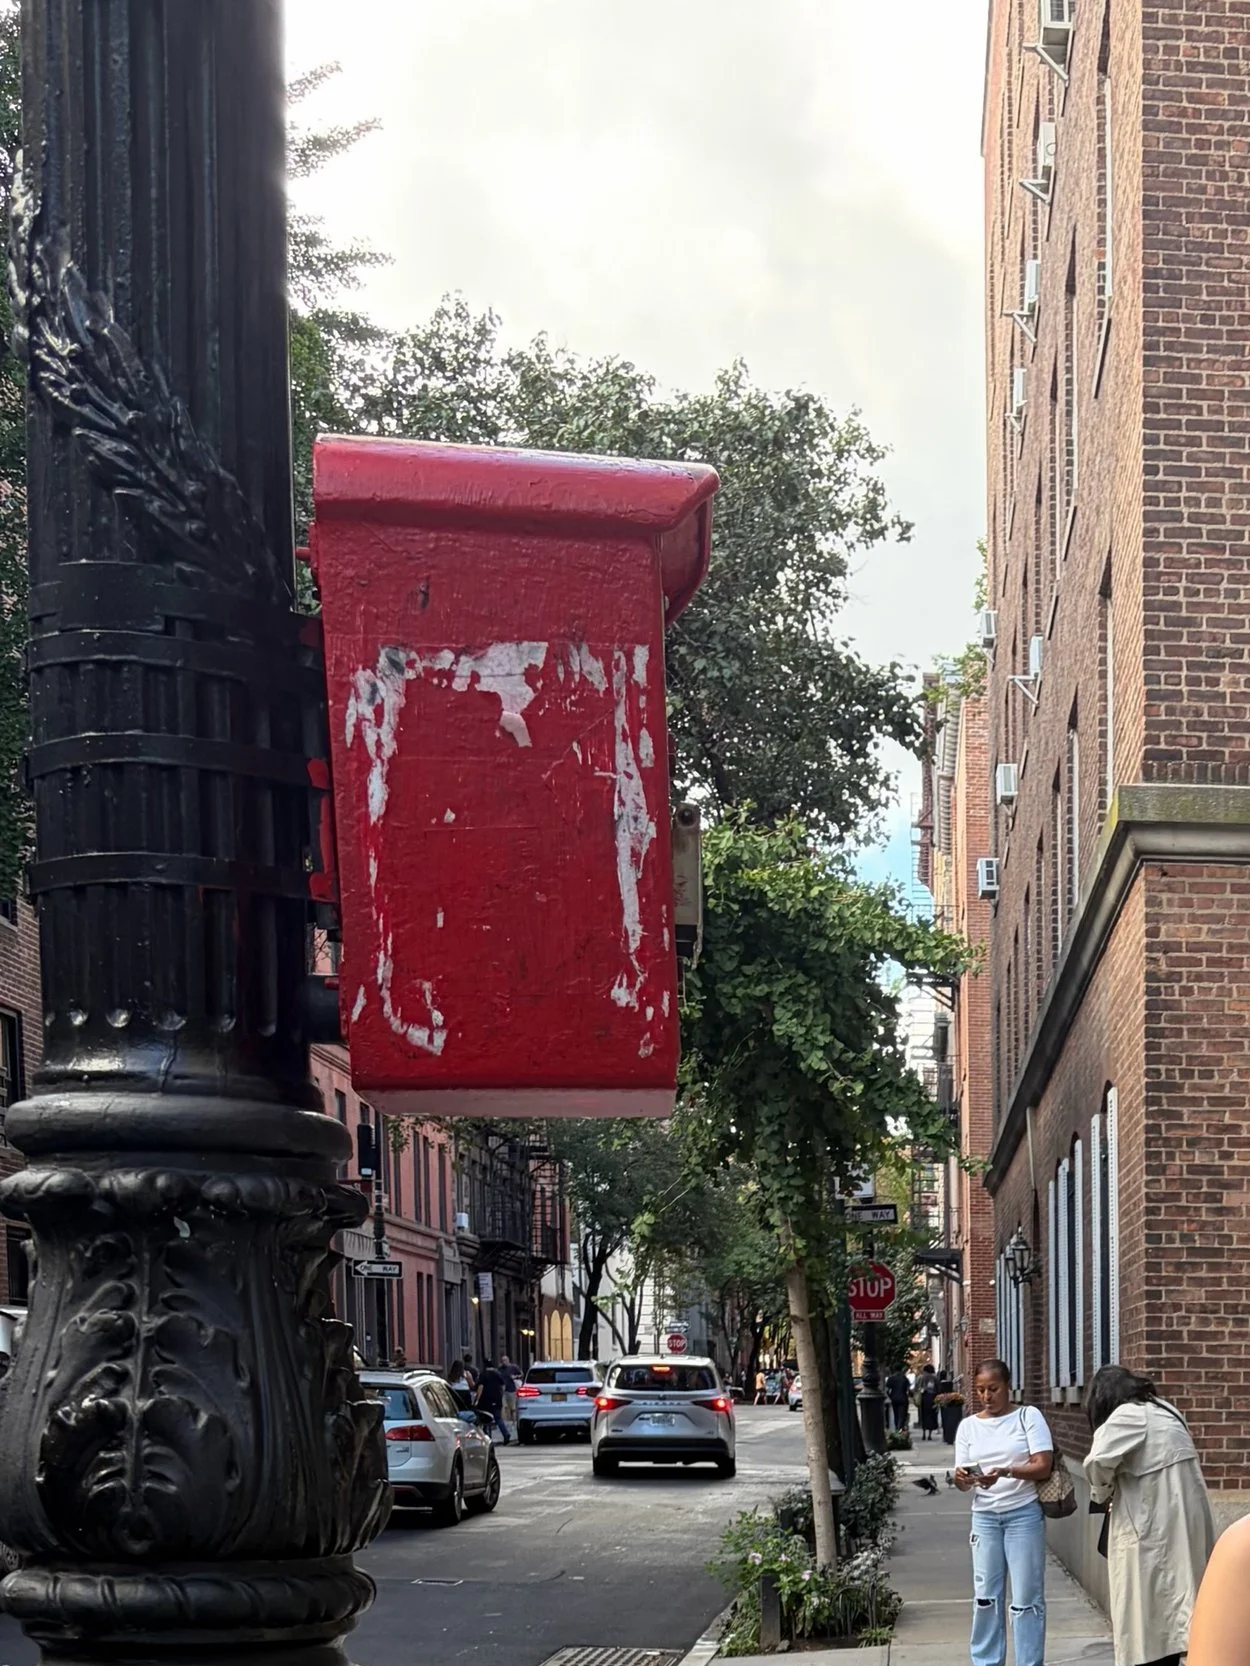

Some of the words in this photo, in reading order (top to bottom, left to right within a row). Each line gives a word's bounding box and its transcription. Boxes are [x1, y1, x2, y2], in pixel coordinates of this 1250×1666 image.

[872, 1211, 890, 1220] WAY
[848, 1277, 892, 1297] STOP
[668, 1339, 686, 1348] STOP
